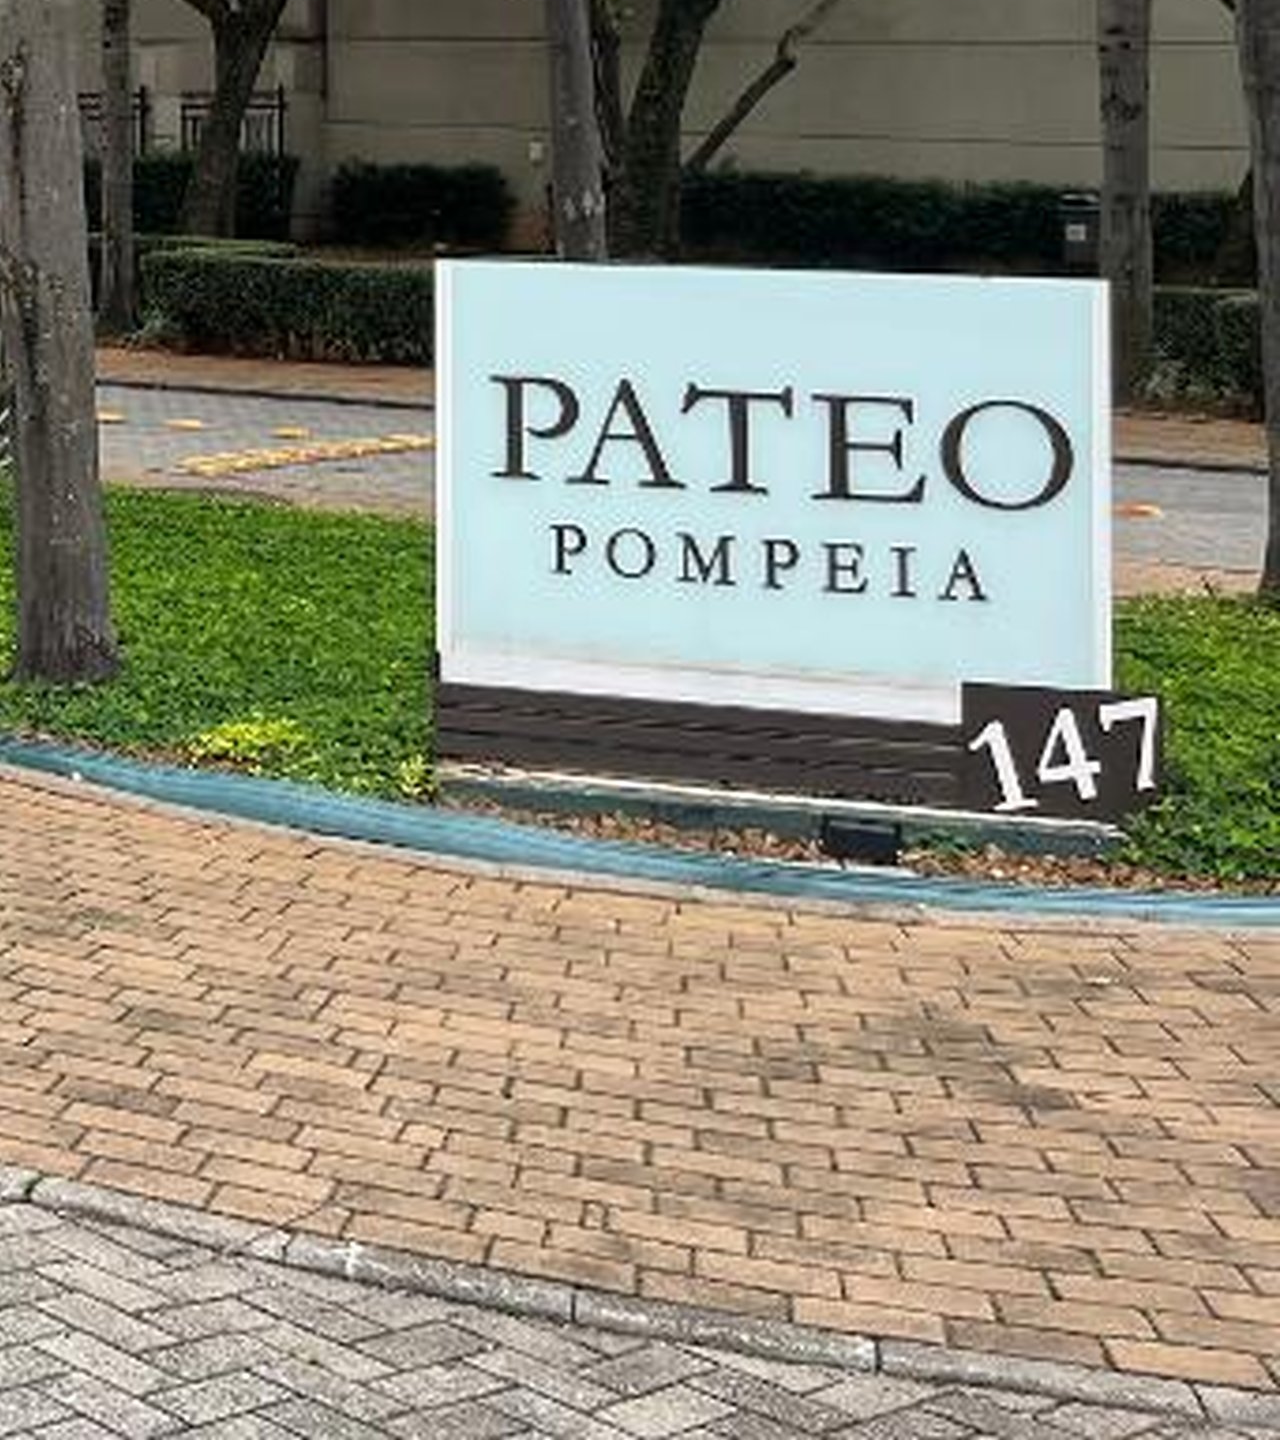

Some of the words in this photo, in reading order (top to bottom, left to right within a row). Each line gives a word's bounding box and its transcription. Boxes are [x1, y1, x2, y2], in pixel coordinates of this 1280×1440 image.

[488, 374, 1075, 511] PATEO
[550, 523, 988, 602] POMPEIA
[968, 697, 1158, 812] 147
